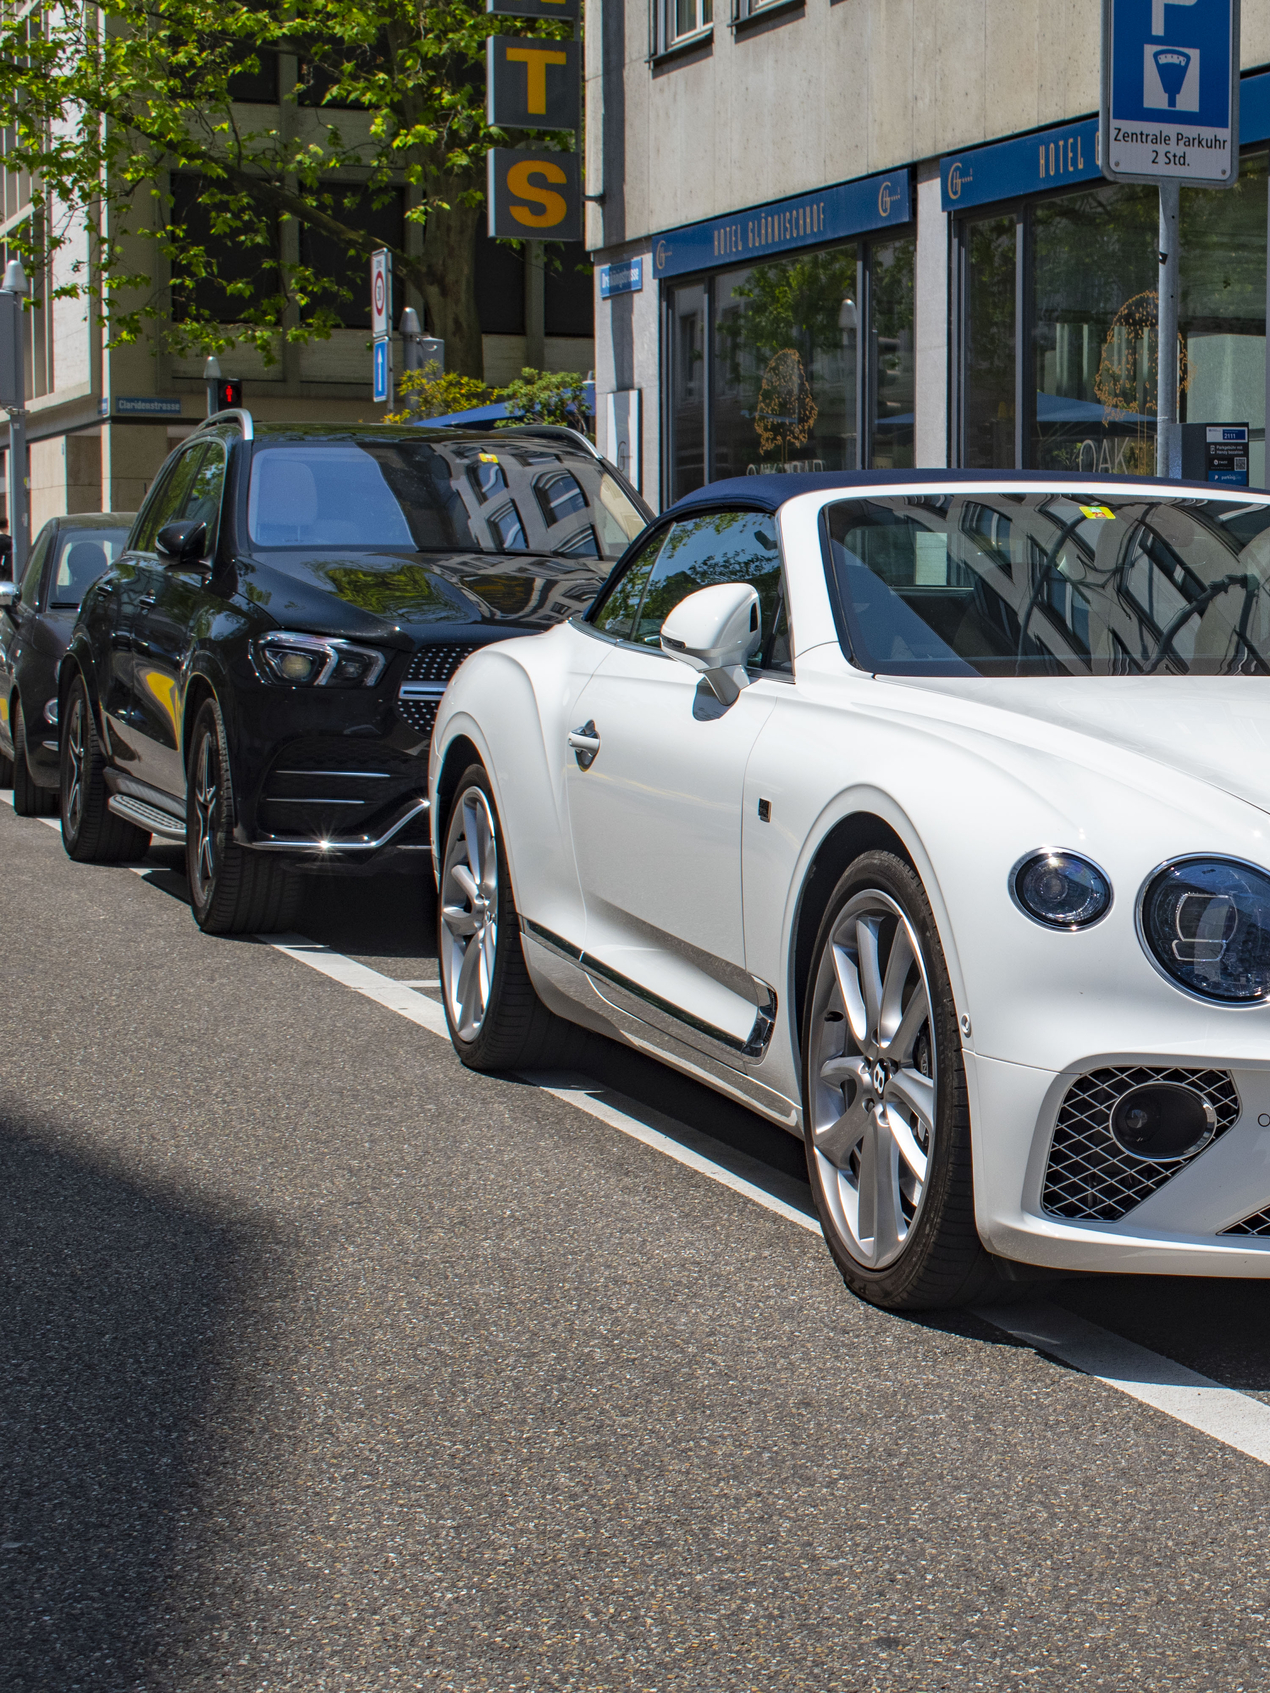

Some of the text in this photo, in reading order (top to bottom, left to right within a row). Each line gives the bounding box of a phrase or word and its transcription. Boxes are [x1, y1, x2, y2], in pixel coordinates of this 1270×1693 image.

[1114, 127, 1228, 150] Zentrale Parkuhr
[1039, 136, 1084, 179] HOTEL
[1151, 149, 1190, 167] 2 Std.
[713, 201, 825, 256] HOTEL GLÄRNISCHHOF
[118, 400, 180, 411] Claridenstrasse
[1079, 437, 1129, 476] OAK
